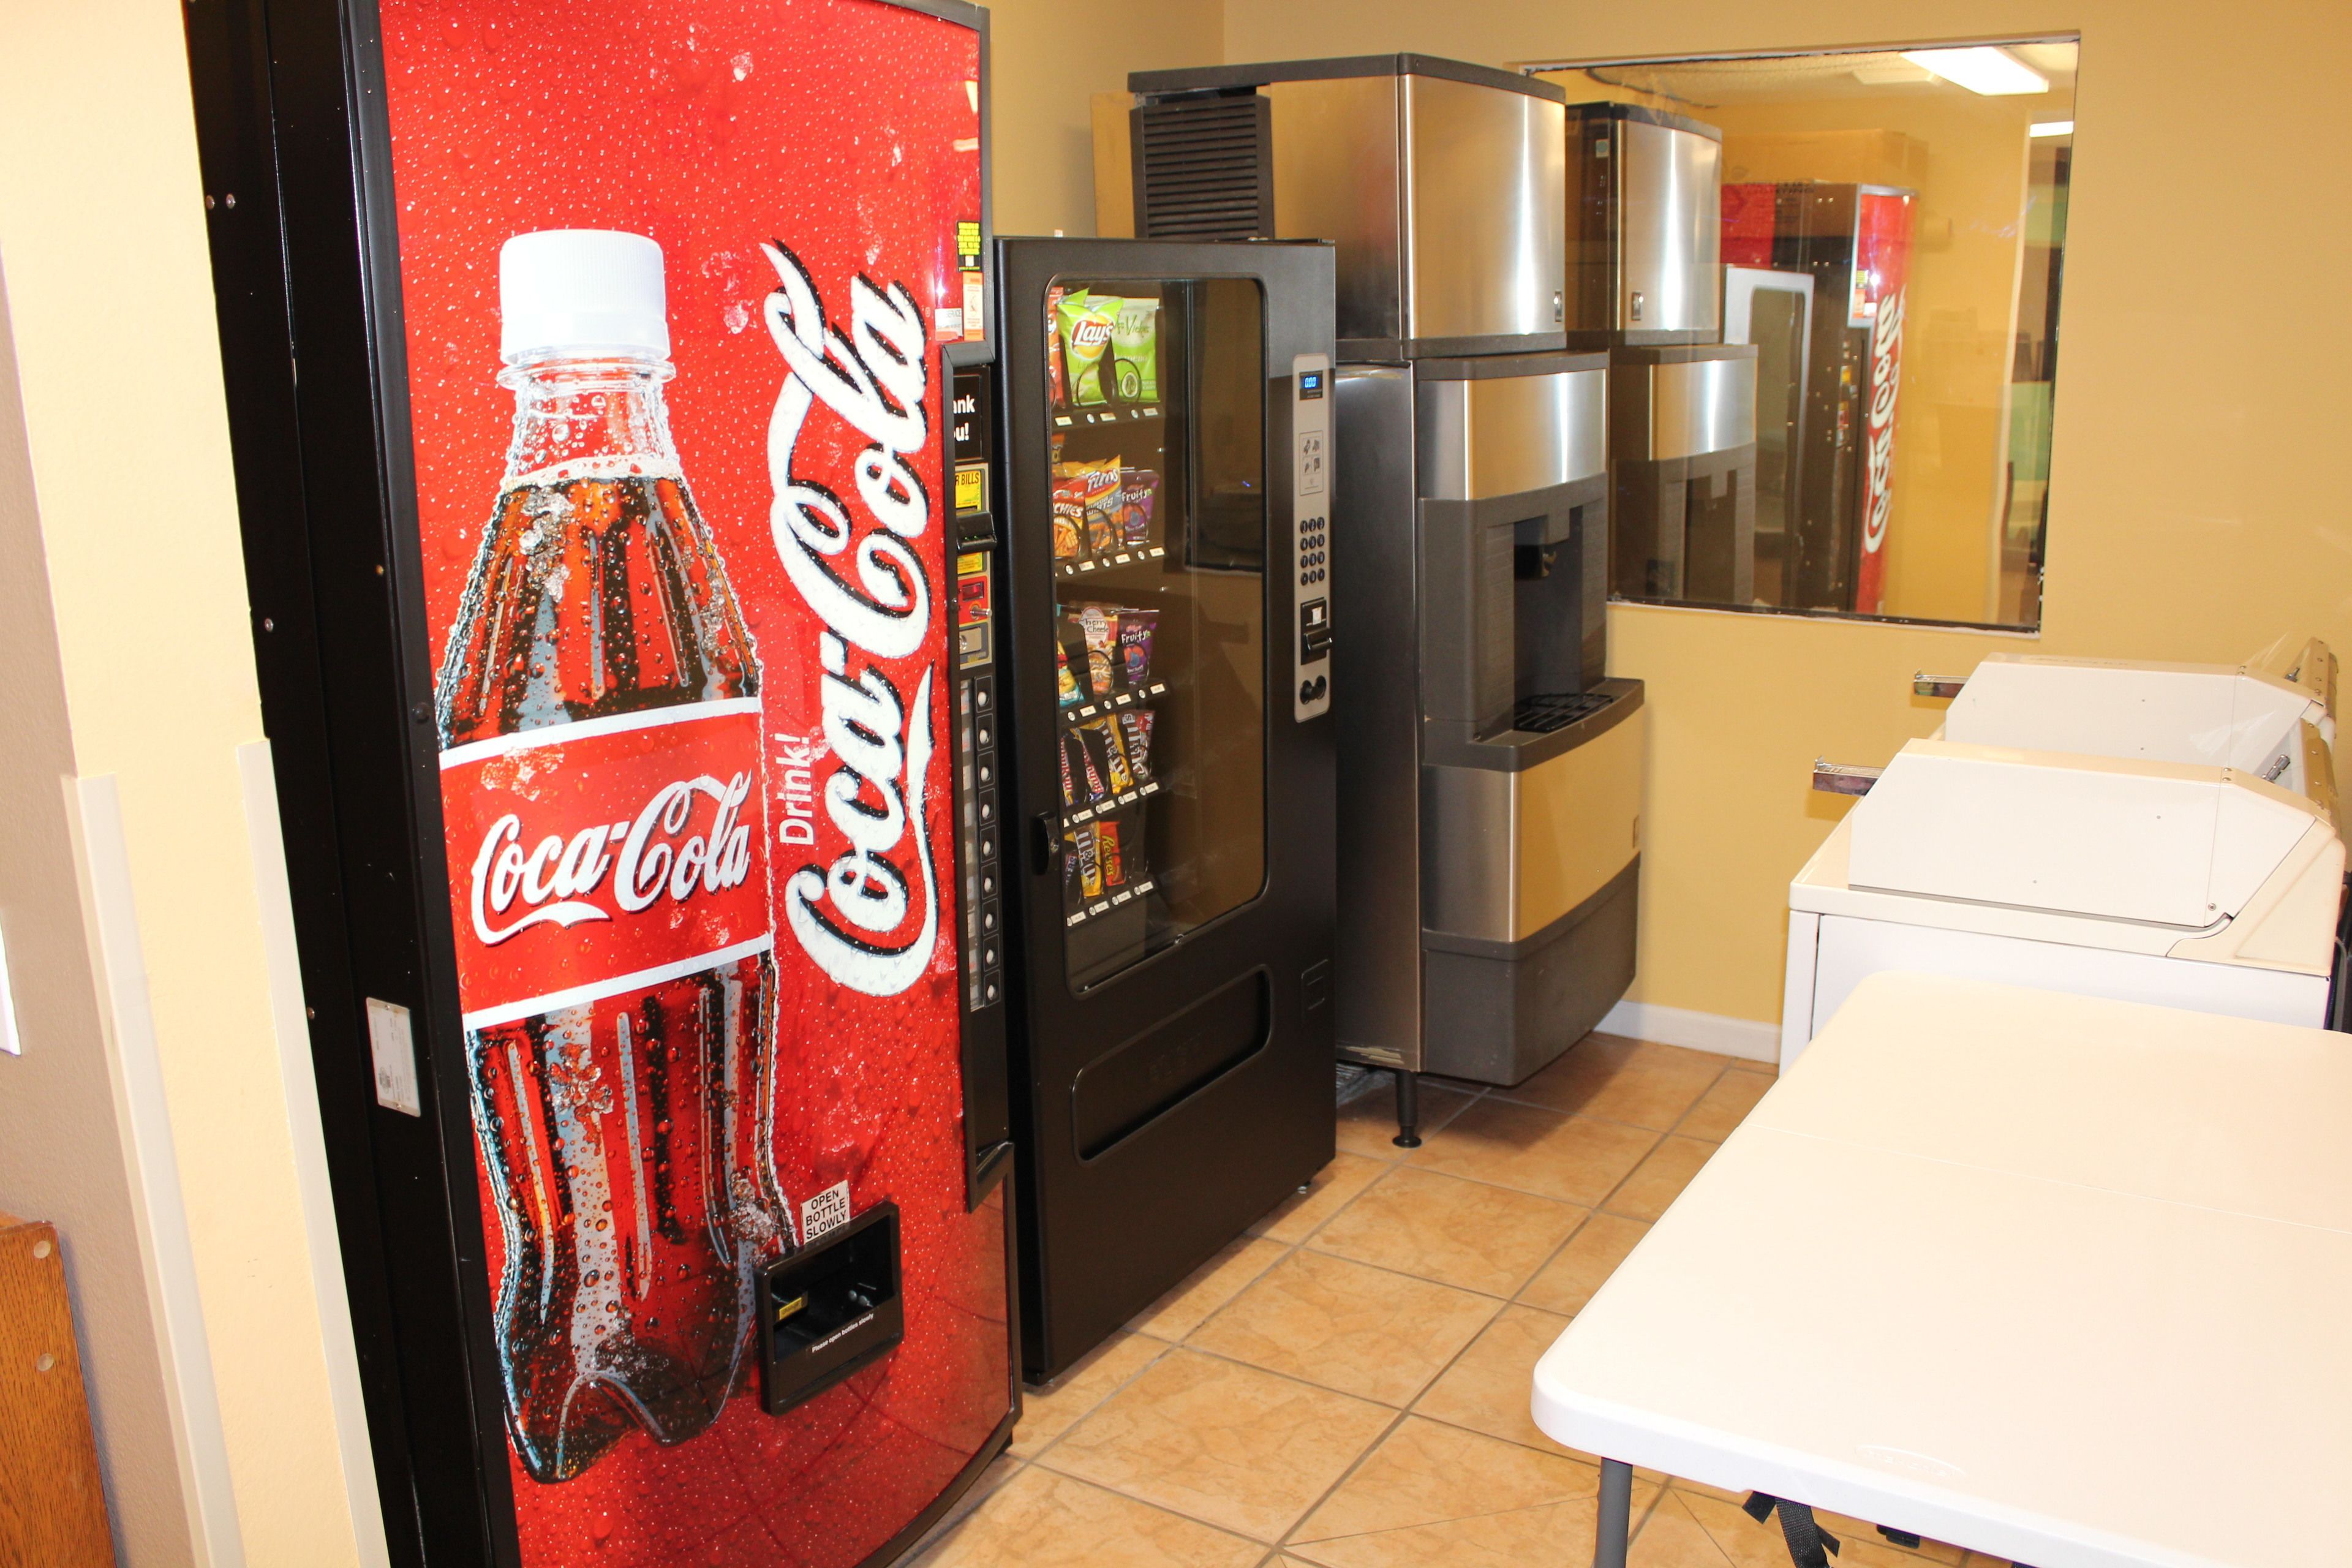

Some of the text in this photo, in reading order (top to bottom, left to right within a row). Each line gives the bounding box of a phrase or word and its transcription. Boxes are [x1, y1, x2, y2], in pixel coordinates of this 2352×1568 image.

[954, 422, 969, 442] u!
[961, 472, 979, 486] BILLS
[1121, 488, 1147, 502] Fruity
[1053, 502, 1084, 518] CHIES
[759, 239, 938, 998] Coca-Cola
[1121, 630, 1147, 644] Fruity
[774, 733, 815, 846] Drink!
[470, 768, 753, 946] Coca-Cola
[805, 1197, 846, 1226] BOTTLE
[811, 1189, 840, 1210] OPEN
[805, 1210, 848, 1240] SLOWLY
[812, 1313, 874, 1353] Please open bottles slowly
